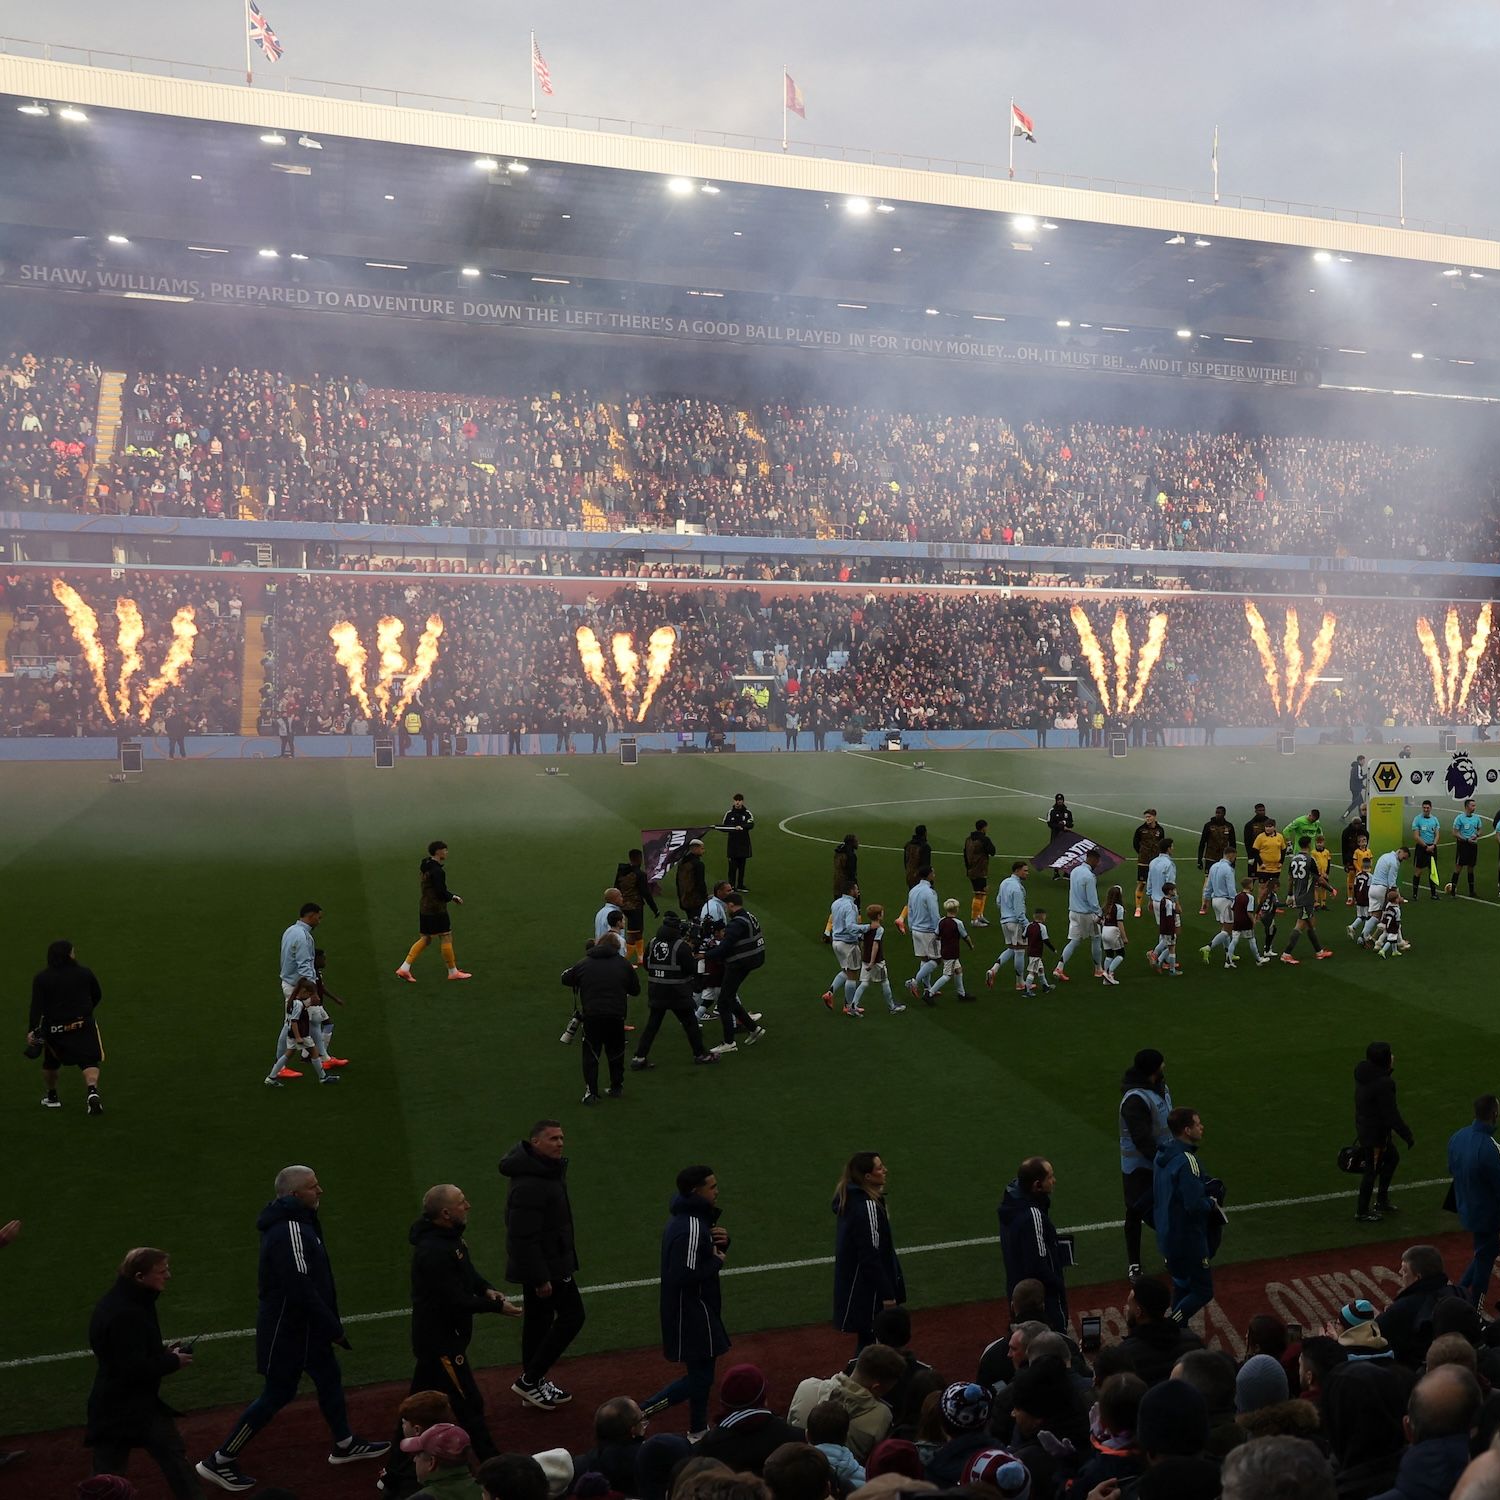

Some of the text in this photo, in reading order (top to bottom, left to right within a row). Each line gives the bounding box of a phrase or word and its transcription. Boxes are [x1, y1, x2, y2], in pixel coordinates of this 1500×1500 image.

[20, 264, 92, 287] SHAW,
[98, 272, 205, 297] WILLIAMS,
[211, 282, 310, 304] PREPARED
[313, 291, 340, 305] TO
[344, 293, 456, 315] ADVENTURE
[463, 302, 521, 321] DOWN
[526, 307, 559, 322] THE
[678, 319, 689, 333] A
[692, 320, 740, 336] GOOD
[745, 324, 783, 340] BALL
[786, 328, 841, 345] PLAYED
[850, 333, 865, 346] IN
[869, 334, 898, 349] FOR
[902, 336, 943, 353] TONY
[1044, 349, 1057, 361] IT
[1059, 350, 1098, 366] MUST
[1171, 360, 1182, 372] IT
[1187, 361, 1202, 374] IS!
[1206, 363, 1246, 378] PETER
[1290, 861, 1307, 879] 23
[1358, 879, 1365, 892] 7
[1385, 915, 1393, 930] 7
